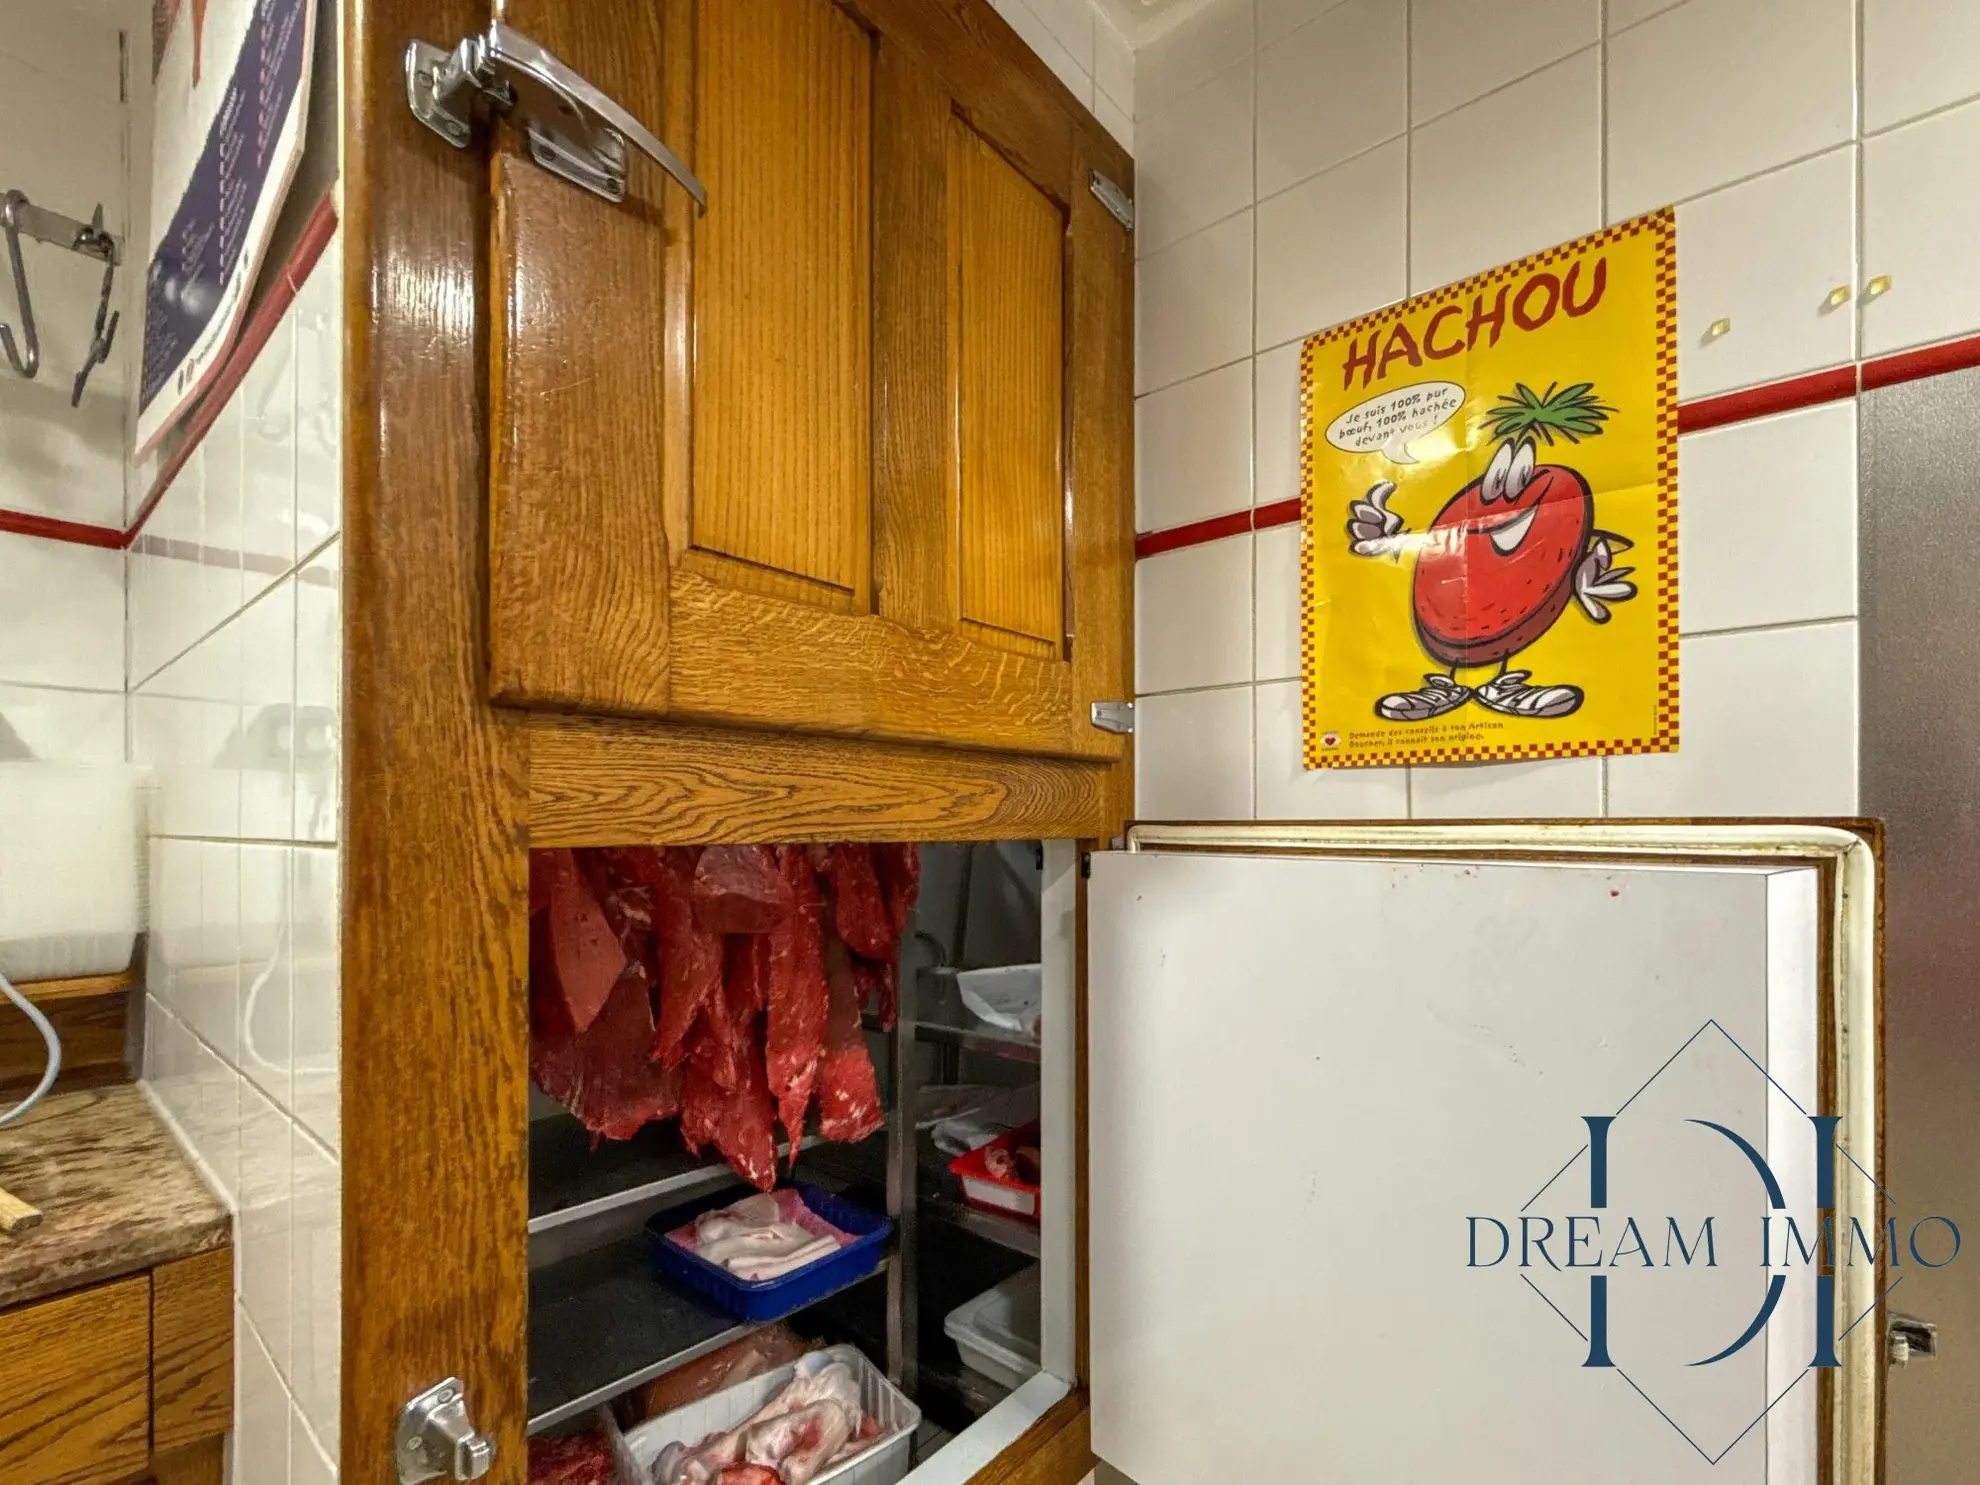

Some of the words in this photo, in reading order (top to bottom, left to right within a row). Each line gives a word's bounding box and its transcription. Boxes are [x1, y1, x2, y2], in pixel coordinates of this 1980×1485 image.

[1343, 257, 1607, 391] HACHOU
[1346, 413, 1360, 424] Je
[1365, 405, 1386, 418] suis
[1390, 393, 1421, 411] 100%
[1426, 387, 1448, 401] pur
[1376, 410, 1407, 428] 100%
[1412, 398, 1457, 418] hachée
[1355, 430, 1395, 447] devant
[1399, 419, 1428, 434] vous
[1349, 730, 1386, 739] Demande
[1405, 725, 1438, 735] conseils
